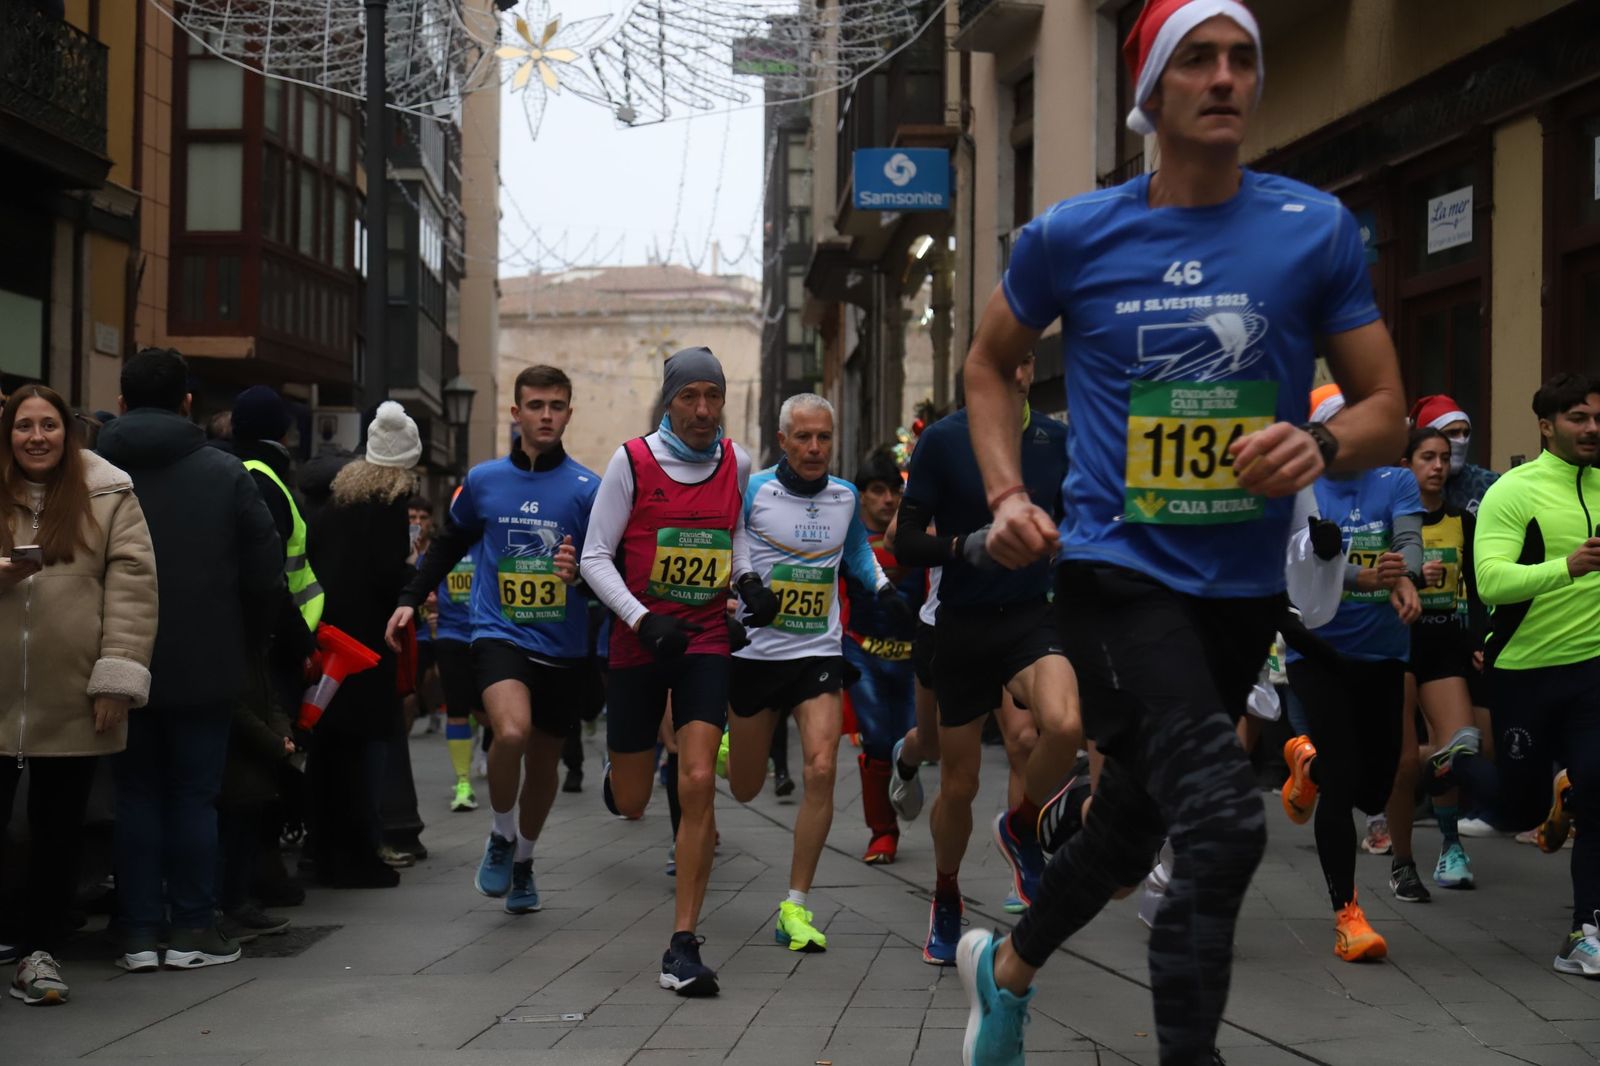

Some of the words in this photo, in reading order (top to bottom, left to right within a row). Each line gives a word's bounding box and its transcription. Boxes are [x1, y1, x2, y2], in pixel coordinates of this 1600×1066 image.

[859, 191, 943, 205] Samsonite
[1431, 201, 1447, 222] La
[1448, 199, 1470, 217] mer
[1162, 260, 1204, 286] 46
[1115, 299, 1142, 314] SAN
[1143, 295, 1213, 312] SILVESTRE
[1215, 293, 1249, 308] 2025
[1144, 422, 1245, 479] 1134
[520, 501, 539, 514] 46
[1168, 498, 1209, 515] CAJA
[1210, 496, 1259, 513] RURAL
[659, 555, 717, 588] 1324
[503, 580, 556, 606] 693
[670, 589, 692, 600] CAJA
[774, 588, 825, 617] 1255
[515, 611, 534, 619] CAJA
[785, 620, 804, 629] CAJA
